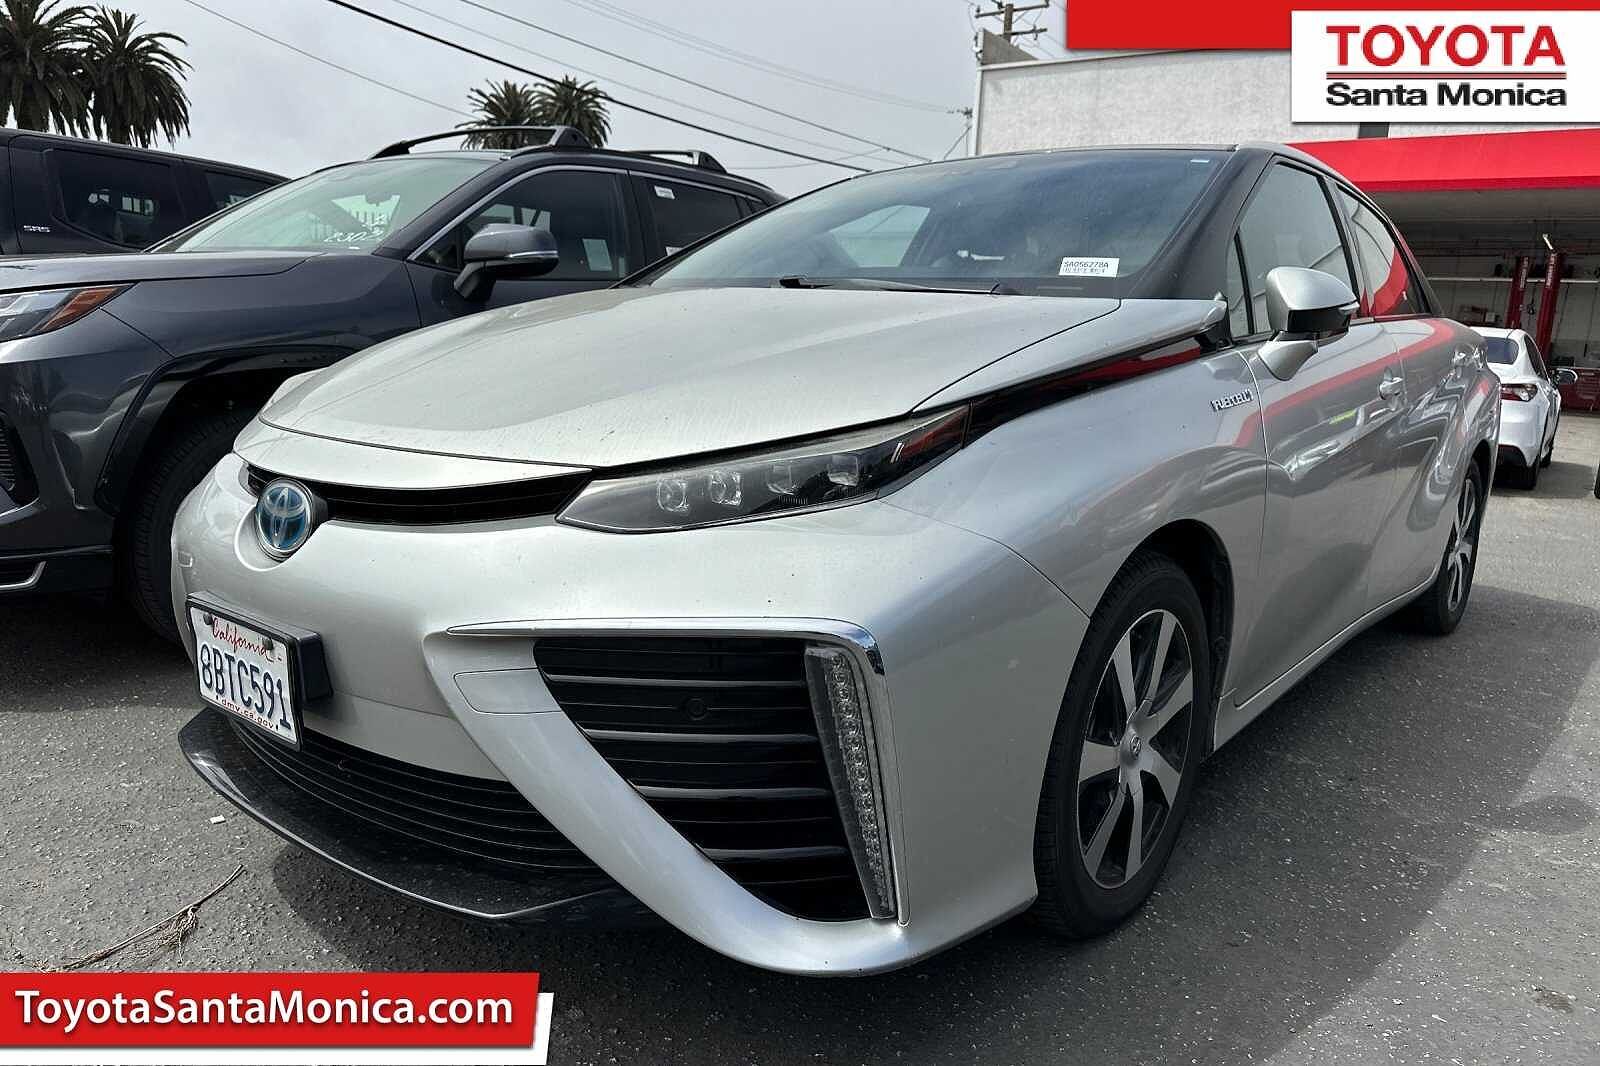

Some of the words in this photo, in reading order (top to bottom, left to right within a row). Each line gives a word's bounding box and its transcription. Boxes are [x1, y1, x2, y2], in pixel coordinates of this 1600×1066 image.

[211, 616, 275, 663] California
[200, 643, 292, 730] 8BTC591
[221, 698, 275, 730] dmv.ca.gov
